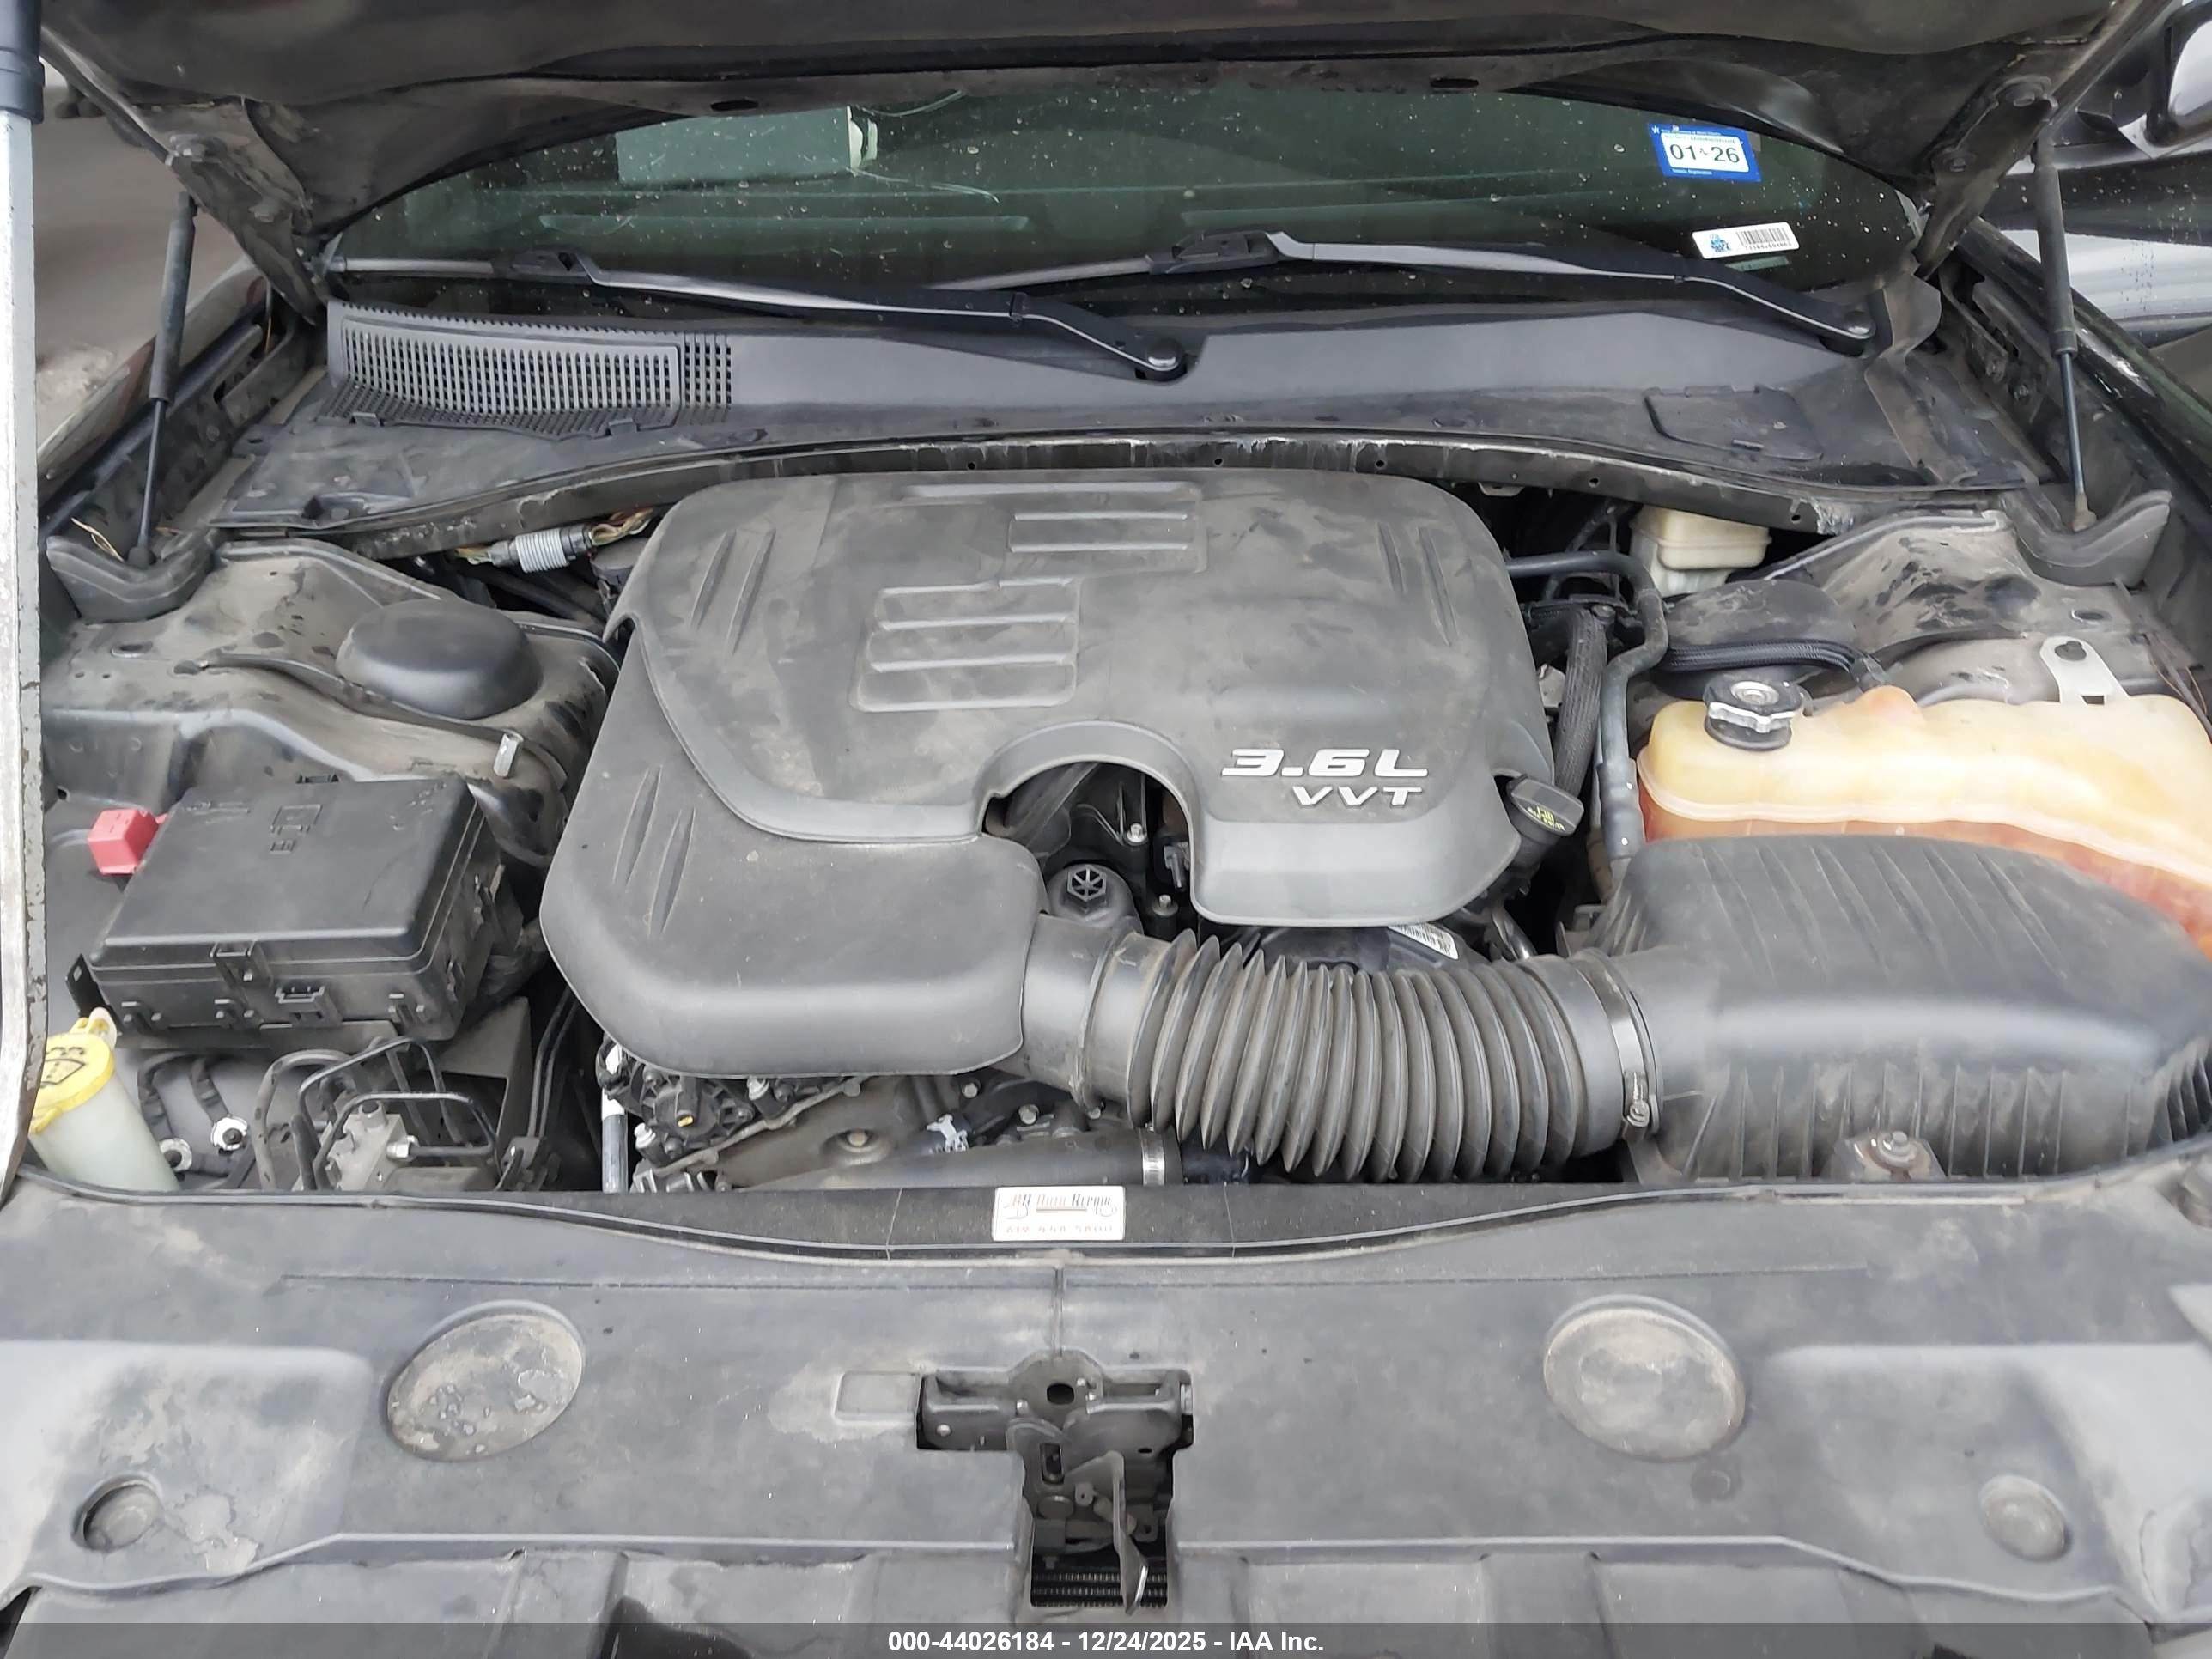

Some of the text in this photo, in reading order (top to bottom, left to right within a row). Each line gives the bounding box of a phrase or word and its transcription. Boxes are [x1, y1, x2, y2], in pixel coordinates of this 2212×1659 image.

[1669, 144, 1740, 163] 01 26
[1221, 748, 1429, 777] 3.6L
[1291, 785, 1423, 806] VVT
